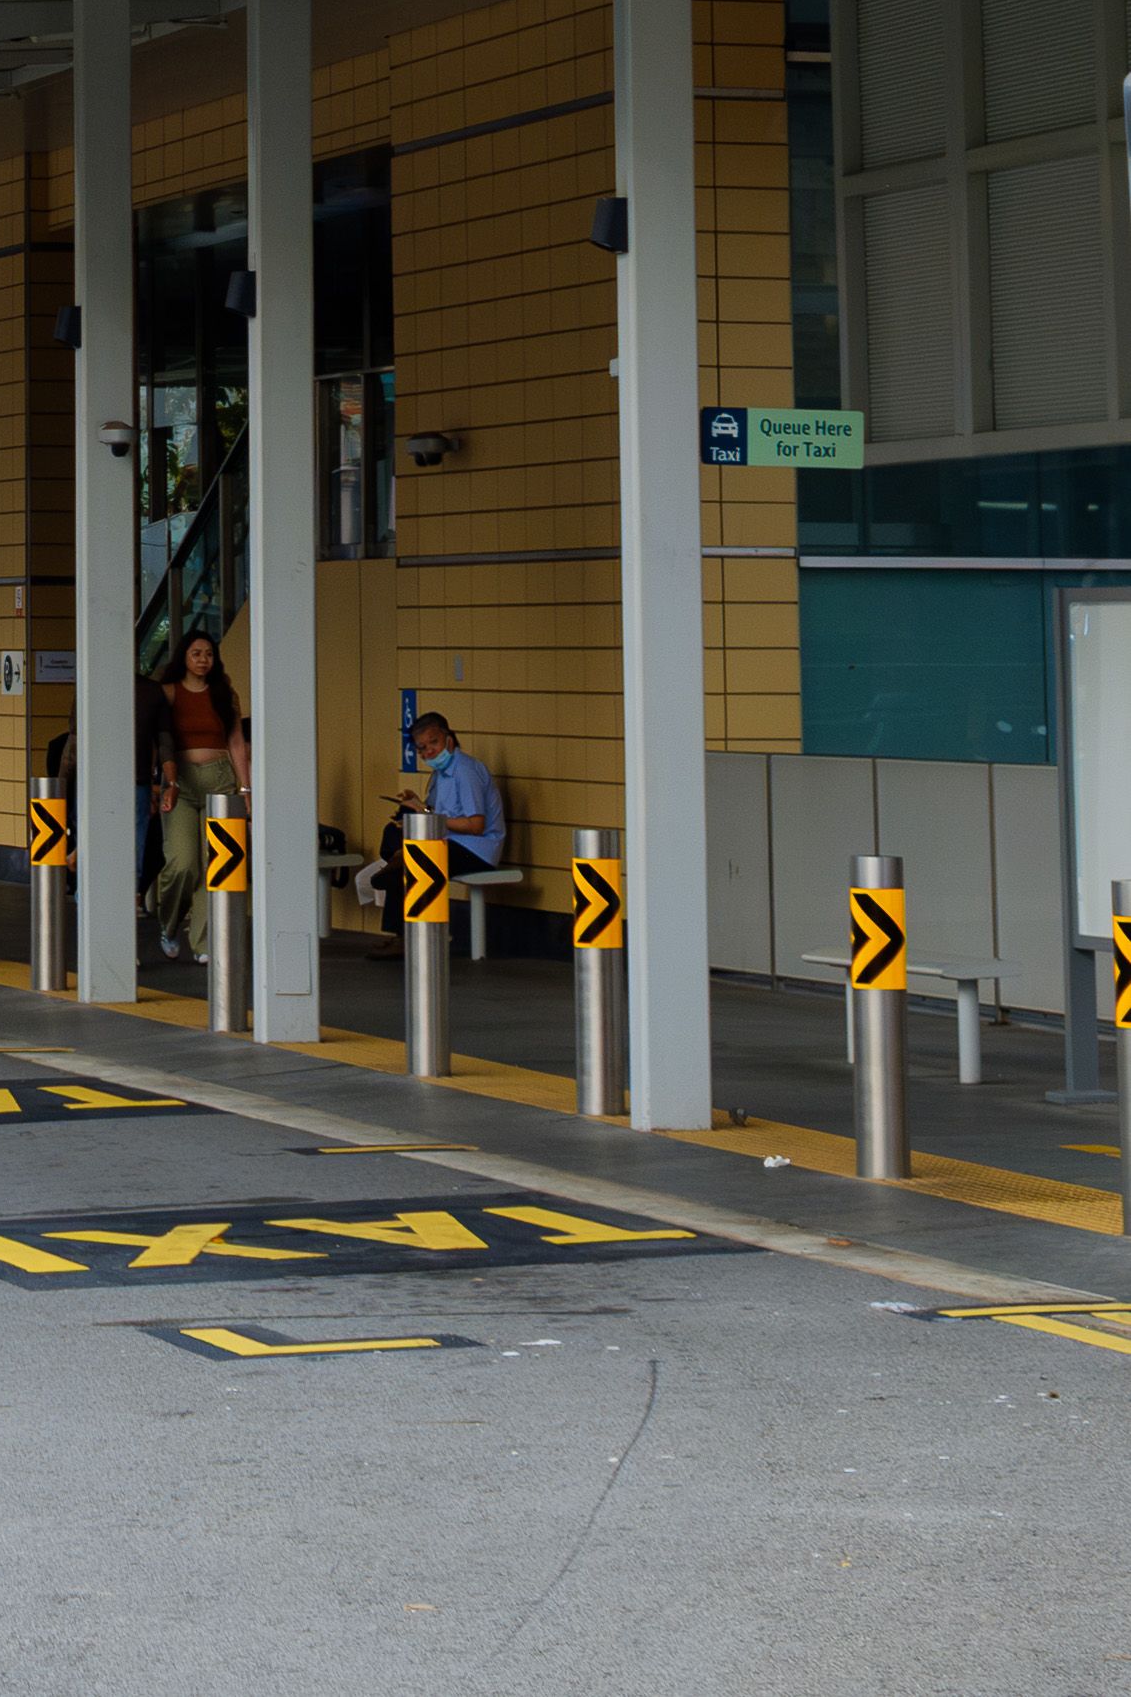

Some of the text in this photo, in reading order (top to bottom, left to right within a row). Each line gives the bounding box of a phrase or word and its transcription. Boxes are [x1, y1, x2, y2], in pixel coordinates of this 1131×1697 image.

[759, 418, 853, 437] Queue Here
[709, 446, 742, 462] Taxi
[776, 440, 838, 458] for Taxi
